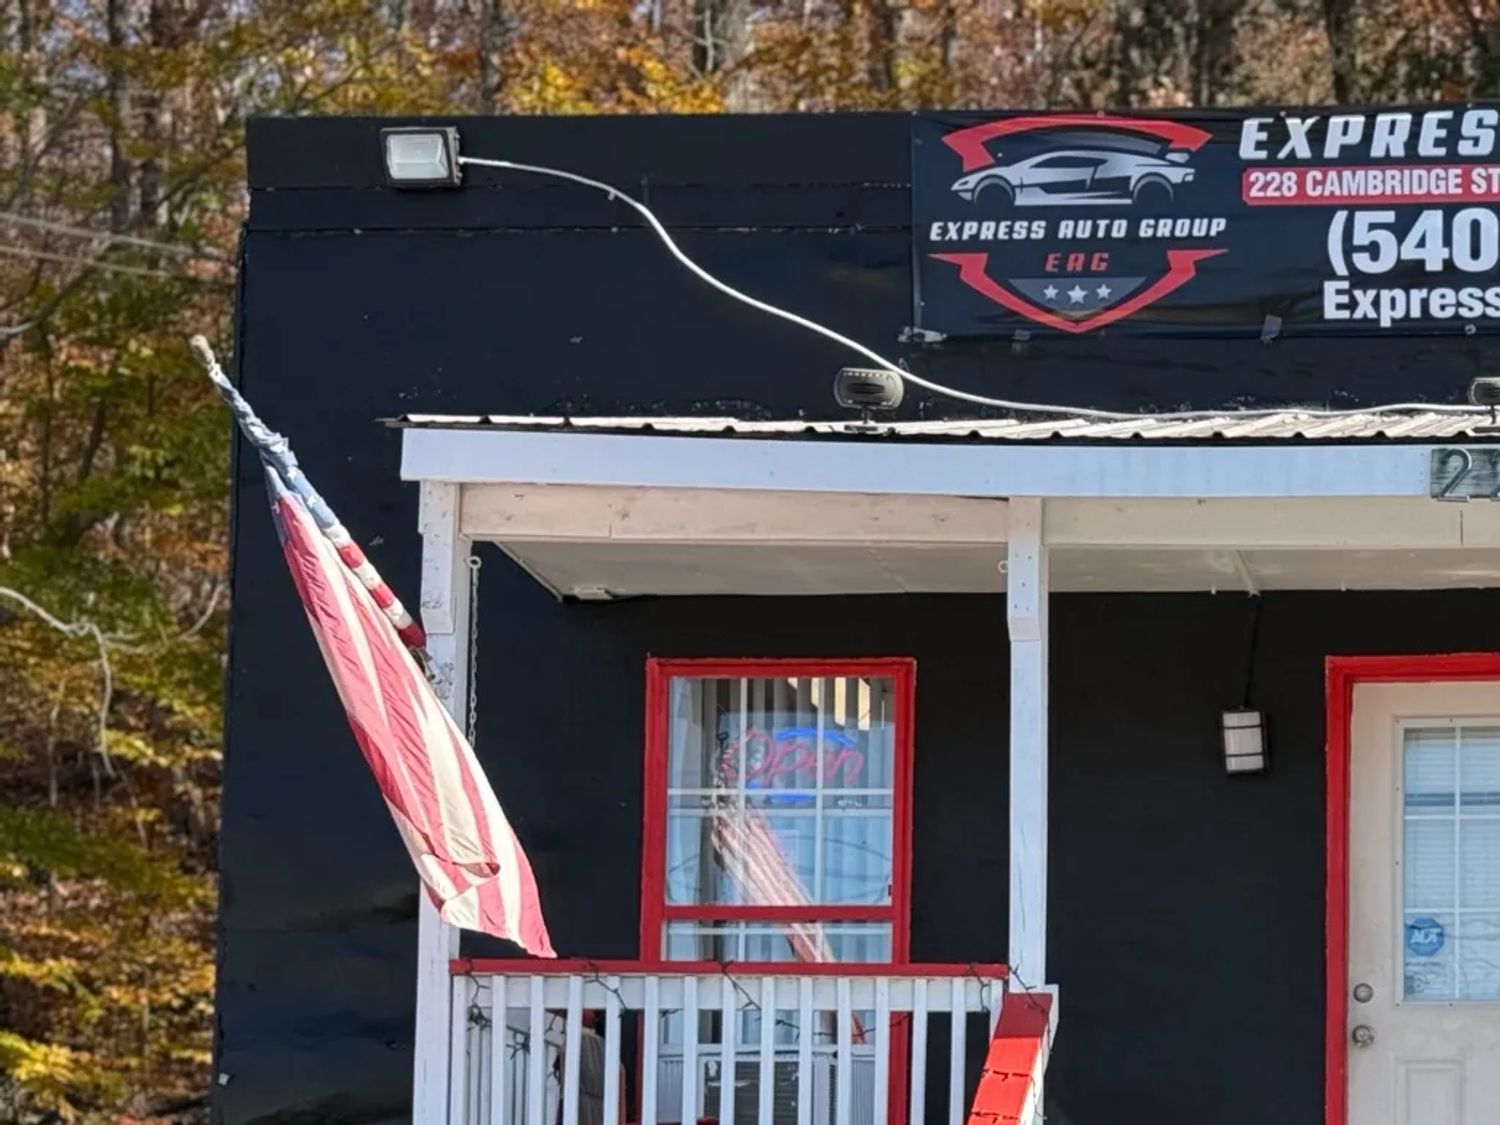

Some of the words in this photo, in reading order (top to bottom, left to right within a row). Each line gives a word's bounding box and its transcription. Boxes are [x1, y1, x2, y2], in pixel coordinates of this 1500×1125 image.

[1249, 172, 1298, 198] 228
[1306, 169, 1462, 197] CAMBRIDGE
[929, 219, 1046, 242] EXPRESS
[1057, 218, 1127, 240] AUTO
[1138, 216, 1227, 238] GROUP
[1045, 252, 1109, 273] EAG
[722, 730, 865, 788] Open
[1410, 928, 1440, 944] ADT
